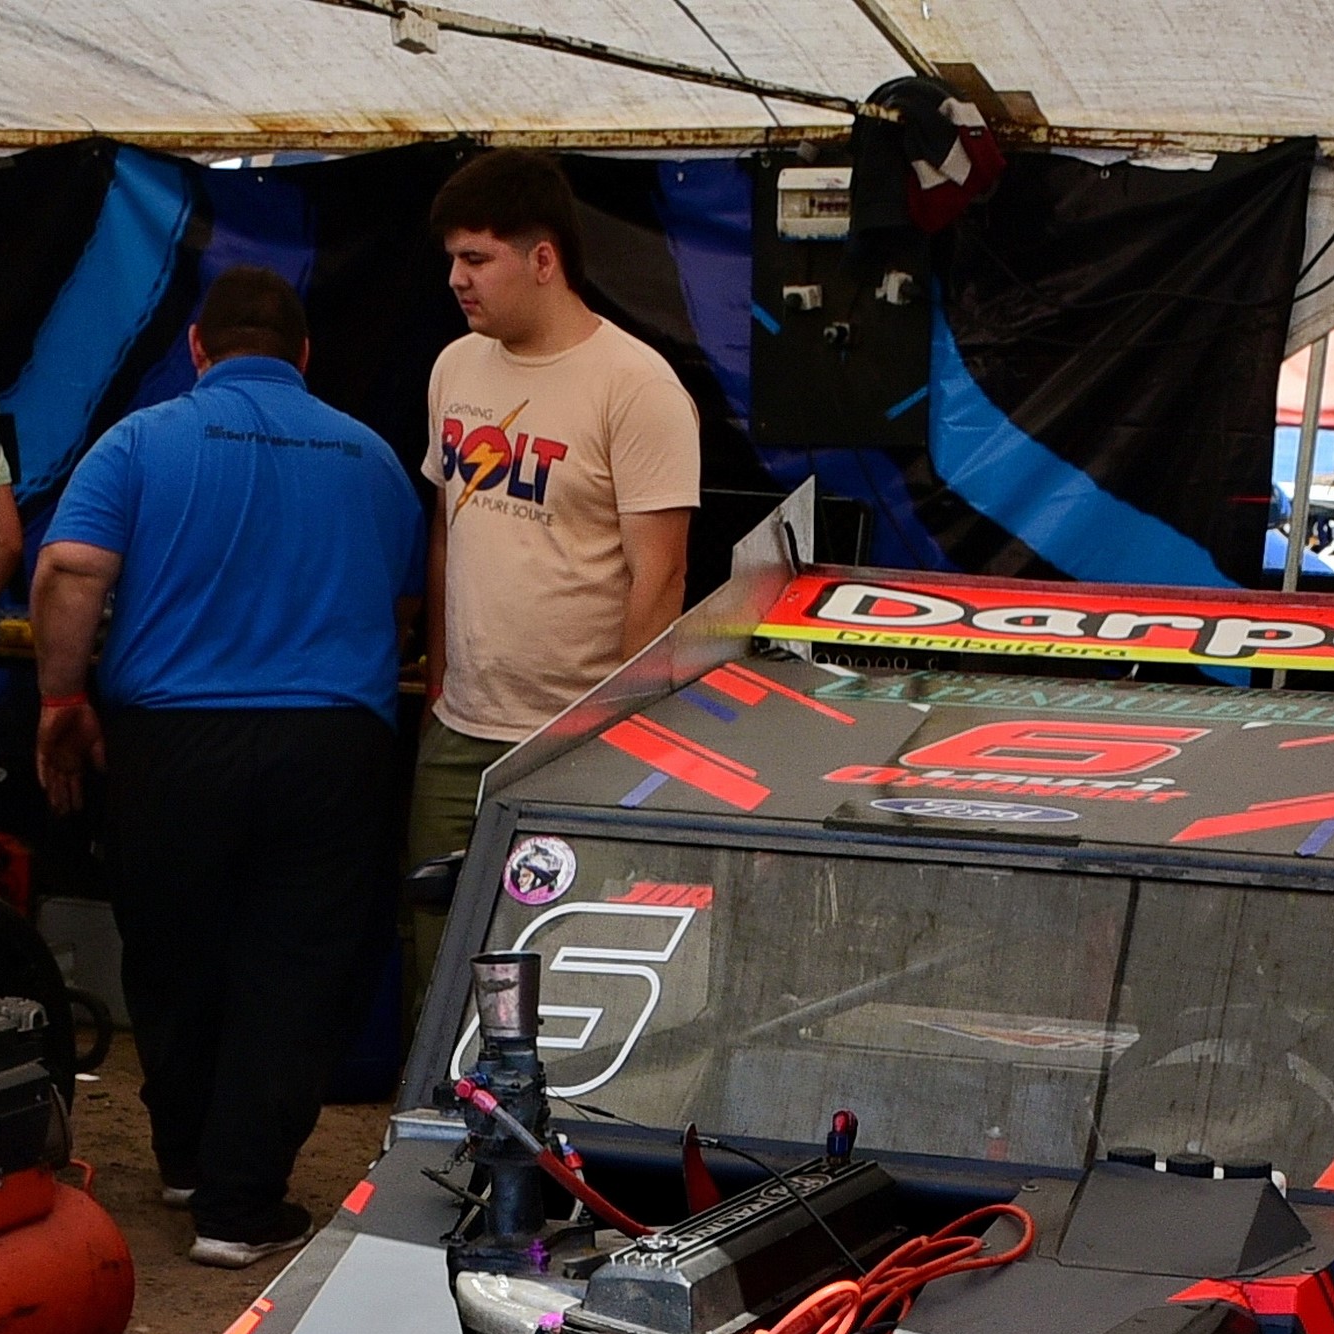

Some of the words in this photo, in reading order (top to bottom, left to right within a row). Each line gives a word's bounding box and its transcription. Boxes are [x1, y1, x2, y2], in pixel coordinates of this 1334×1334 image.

[442, 418, 568, 505] BOLT
[481, 499, 510, 515] PURE
[835, 629, 1128, 657] Distribuidora
[898, 720, 1212, 775] 6
[450, 902, 696, 1098] 6
